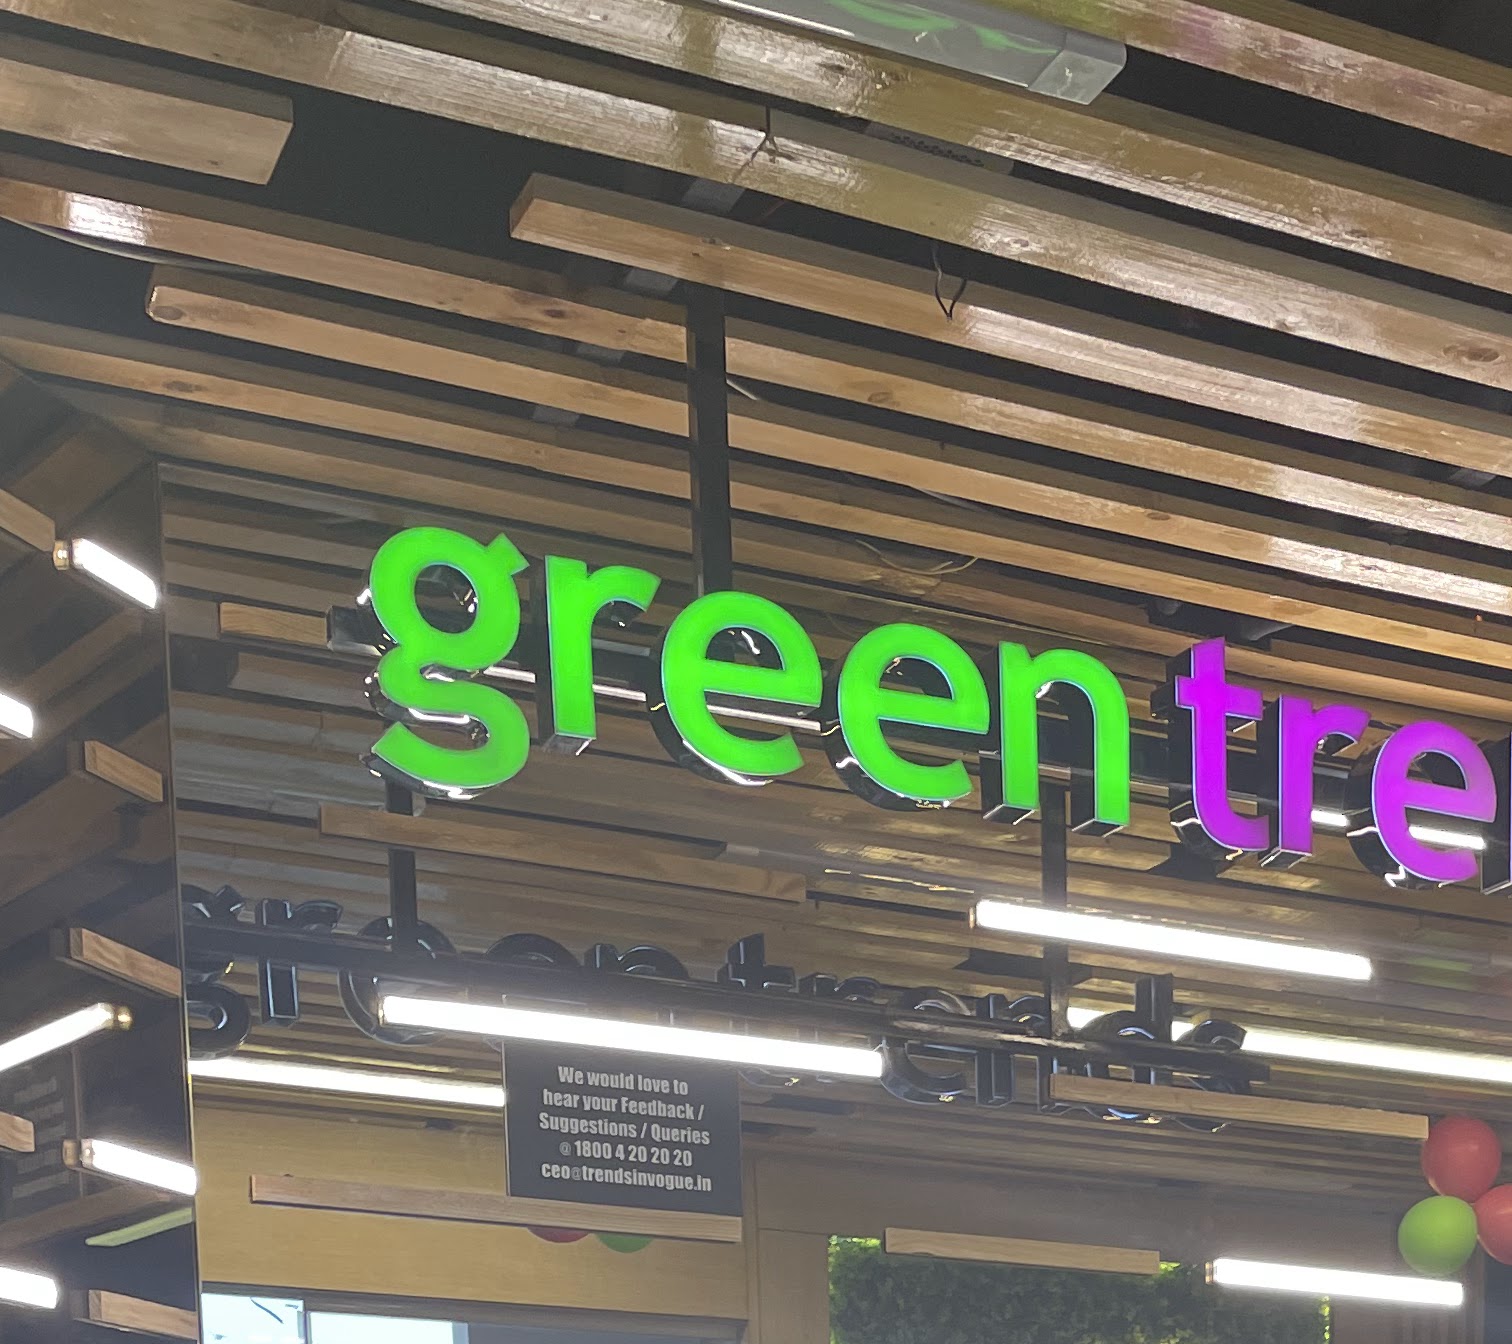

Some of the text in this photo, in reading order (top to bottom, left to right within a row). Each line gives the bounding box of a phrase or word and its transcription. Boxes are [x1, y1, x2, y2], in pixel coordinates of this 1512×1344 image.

[368, 526, 1132, 833] green
[558, 1066, 688, 1096] We would love to
[543, 1089, 579, 1109] hear
[583, 1096, 617, 1112] your
[621, 1096, 694, 1120] Feedback
[539, 1112, 637, 1138] Suggestions
[651, 1123, 711, 1145] Queries
[559, 1140, 693, 1167] @ 1800 4 20 20 20
[541, 1163, 712, 1192] ceo@trendsinvogue.in
